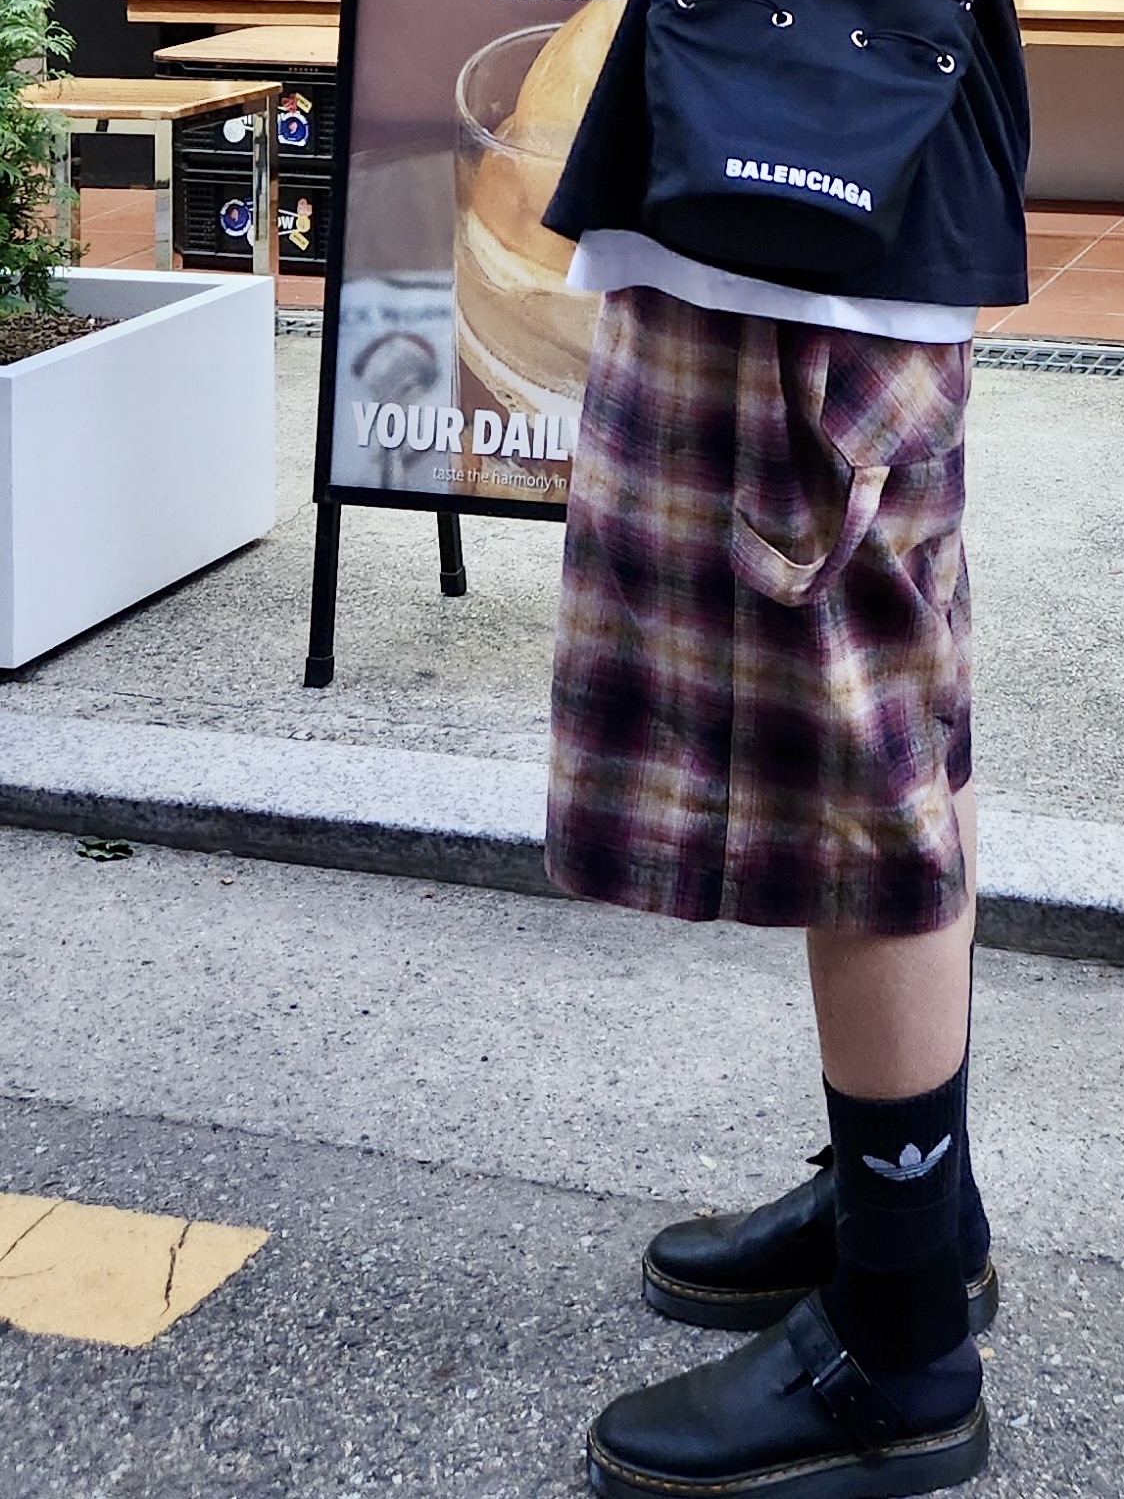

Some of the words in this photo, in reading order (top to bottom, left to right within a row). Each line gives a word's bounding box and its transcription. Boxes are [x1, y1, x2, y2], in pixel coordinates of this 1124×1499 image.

[724, 158, 873, 212] BALENCIAGA
[352, 401, 465, 453] YOUR
[432, 466, 465, 482] taste
[467, 468, 489, 483] the
[491, 469, 552, 492] harmony
[554, 474, 568, 490] in
